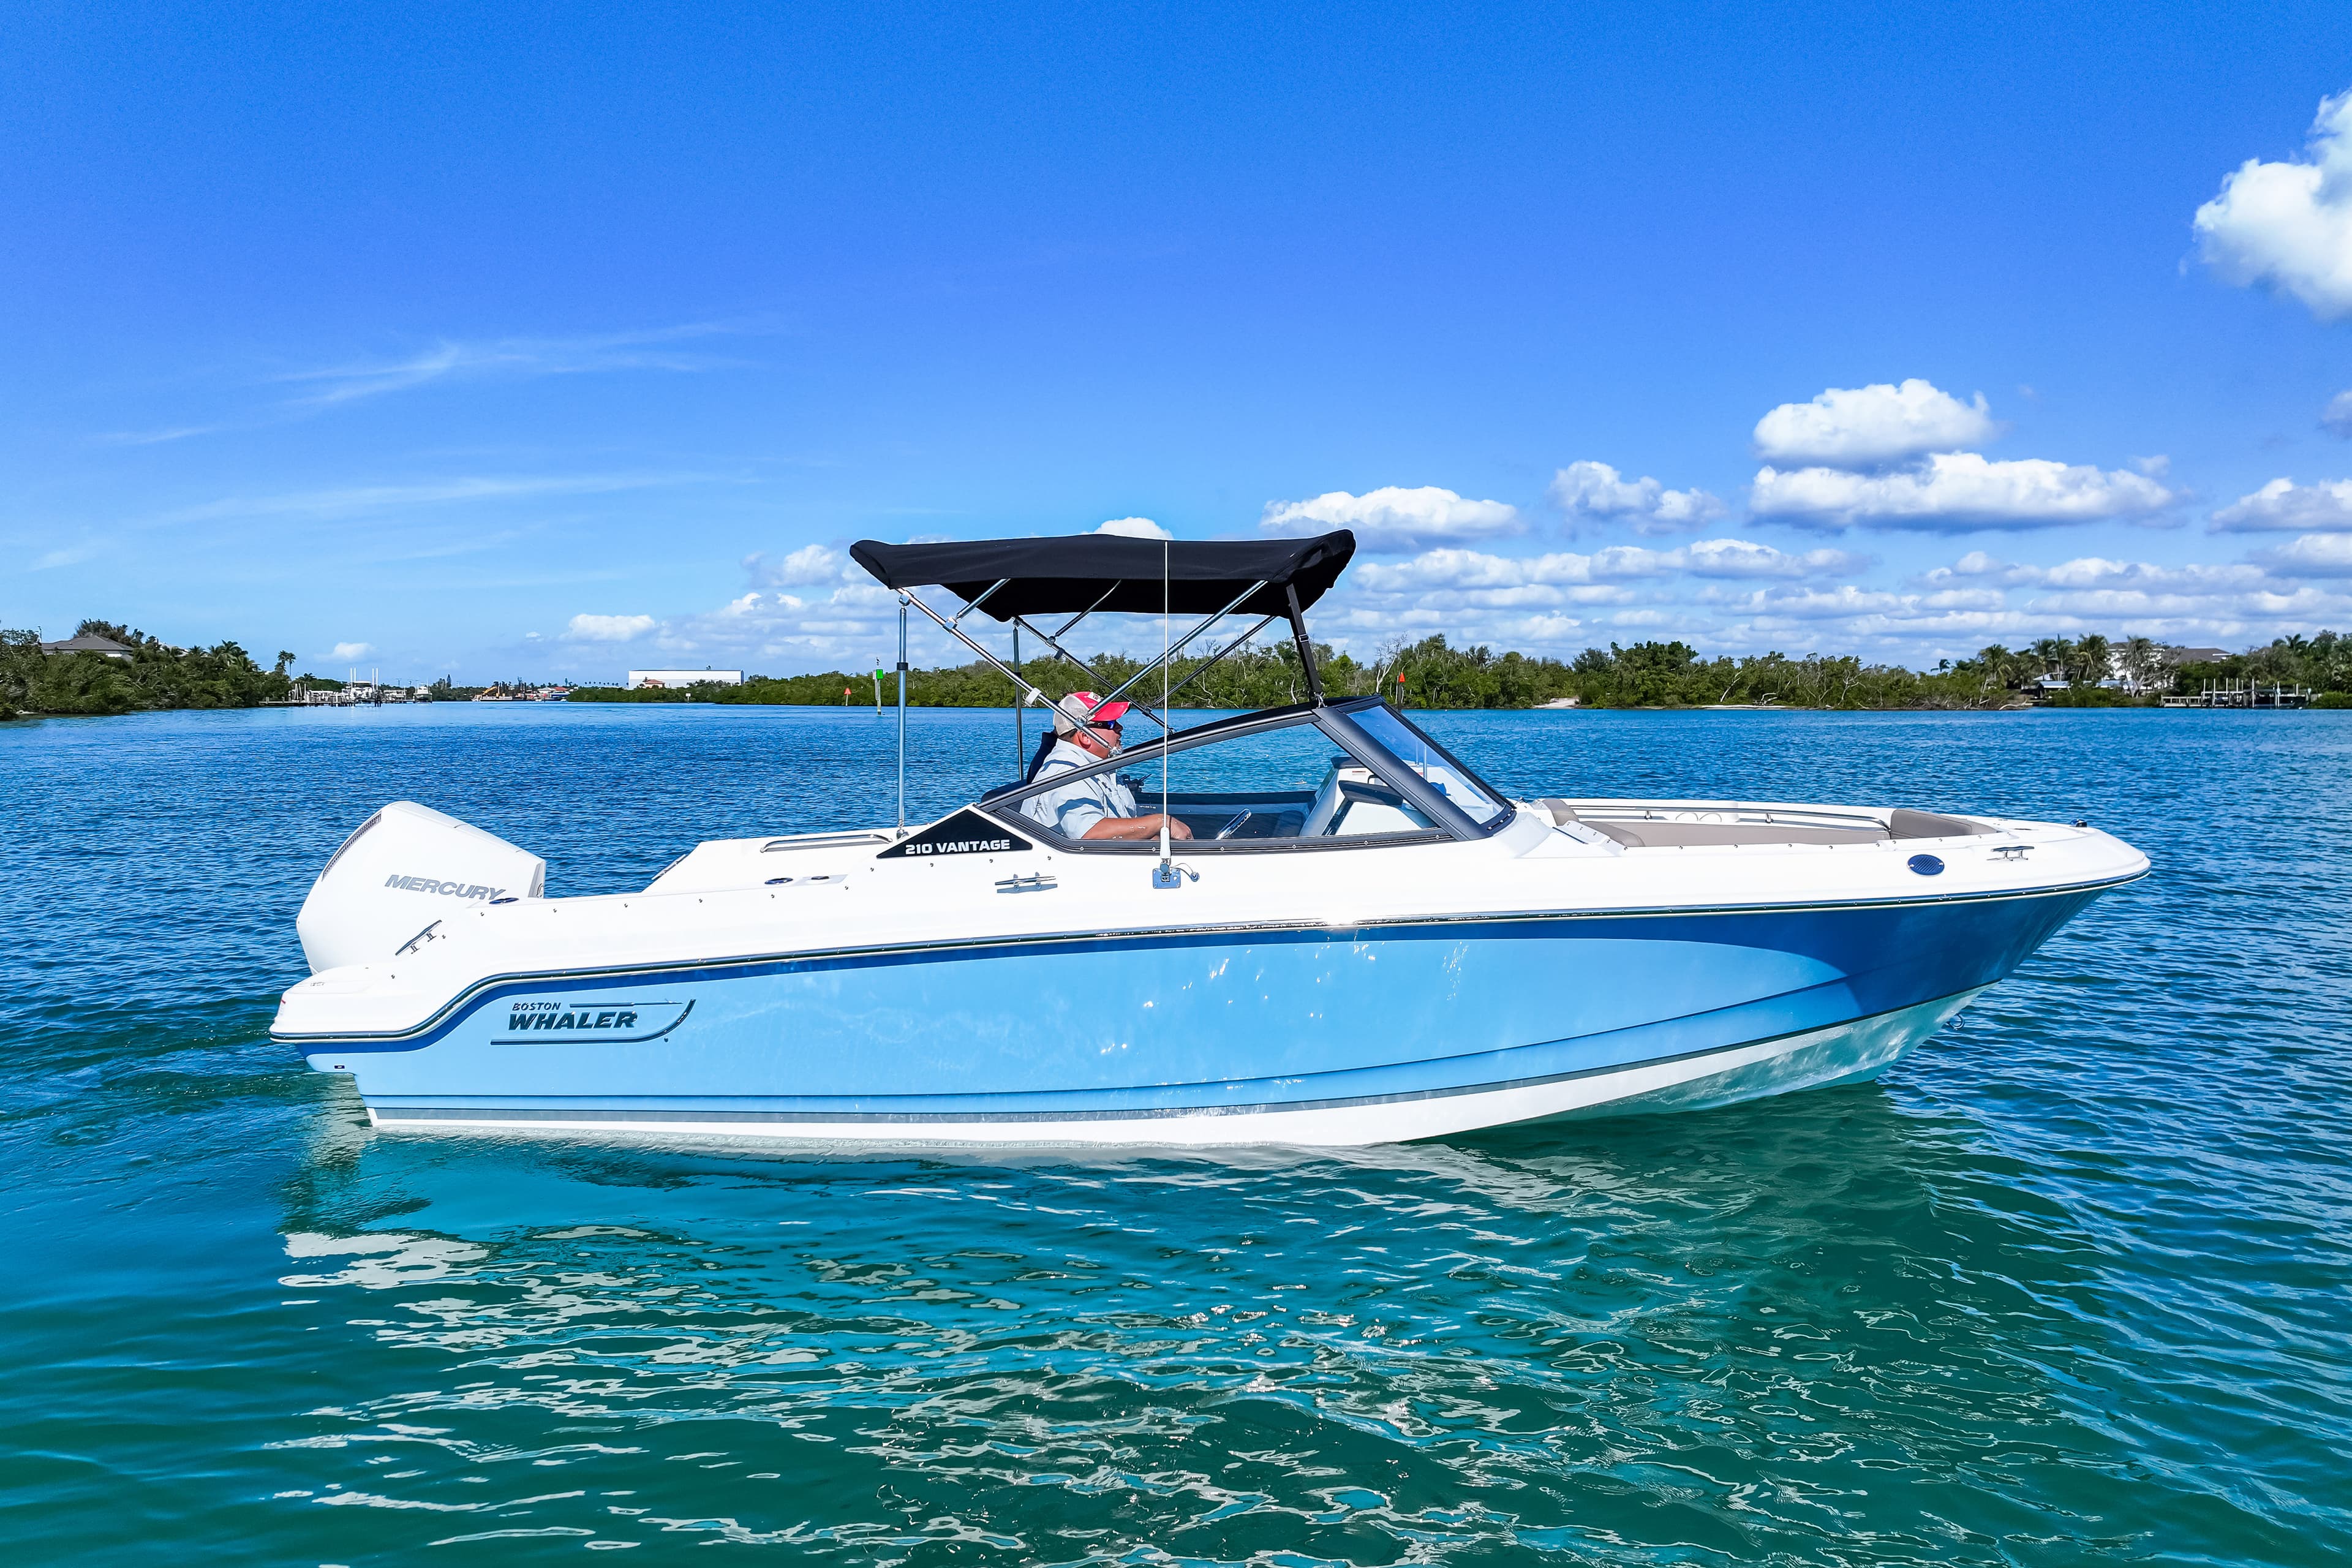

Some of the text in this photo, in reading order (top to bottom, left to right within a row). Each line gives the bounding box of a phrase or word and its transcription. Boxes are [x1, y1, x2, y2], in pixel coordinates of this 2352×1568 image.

[905, 839, 1010, 854] 210 VANTAGE
[384, 874, 507, 900] MERCURY
[511, 1002, 561, 1011] BOSTON
[508, 1011, 638, 1031] WHALER
